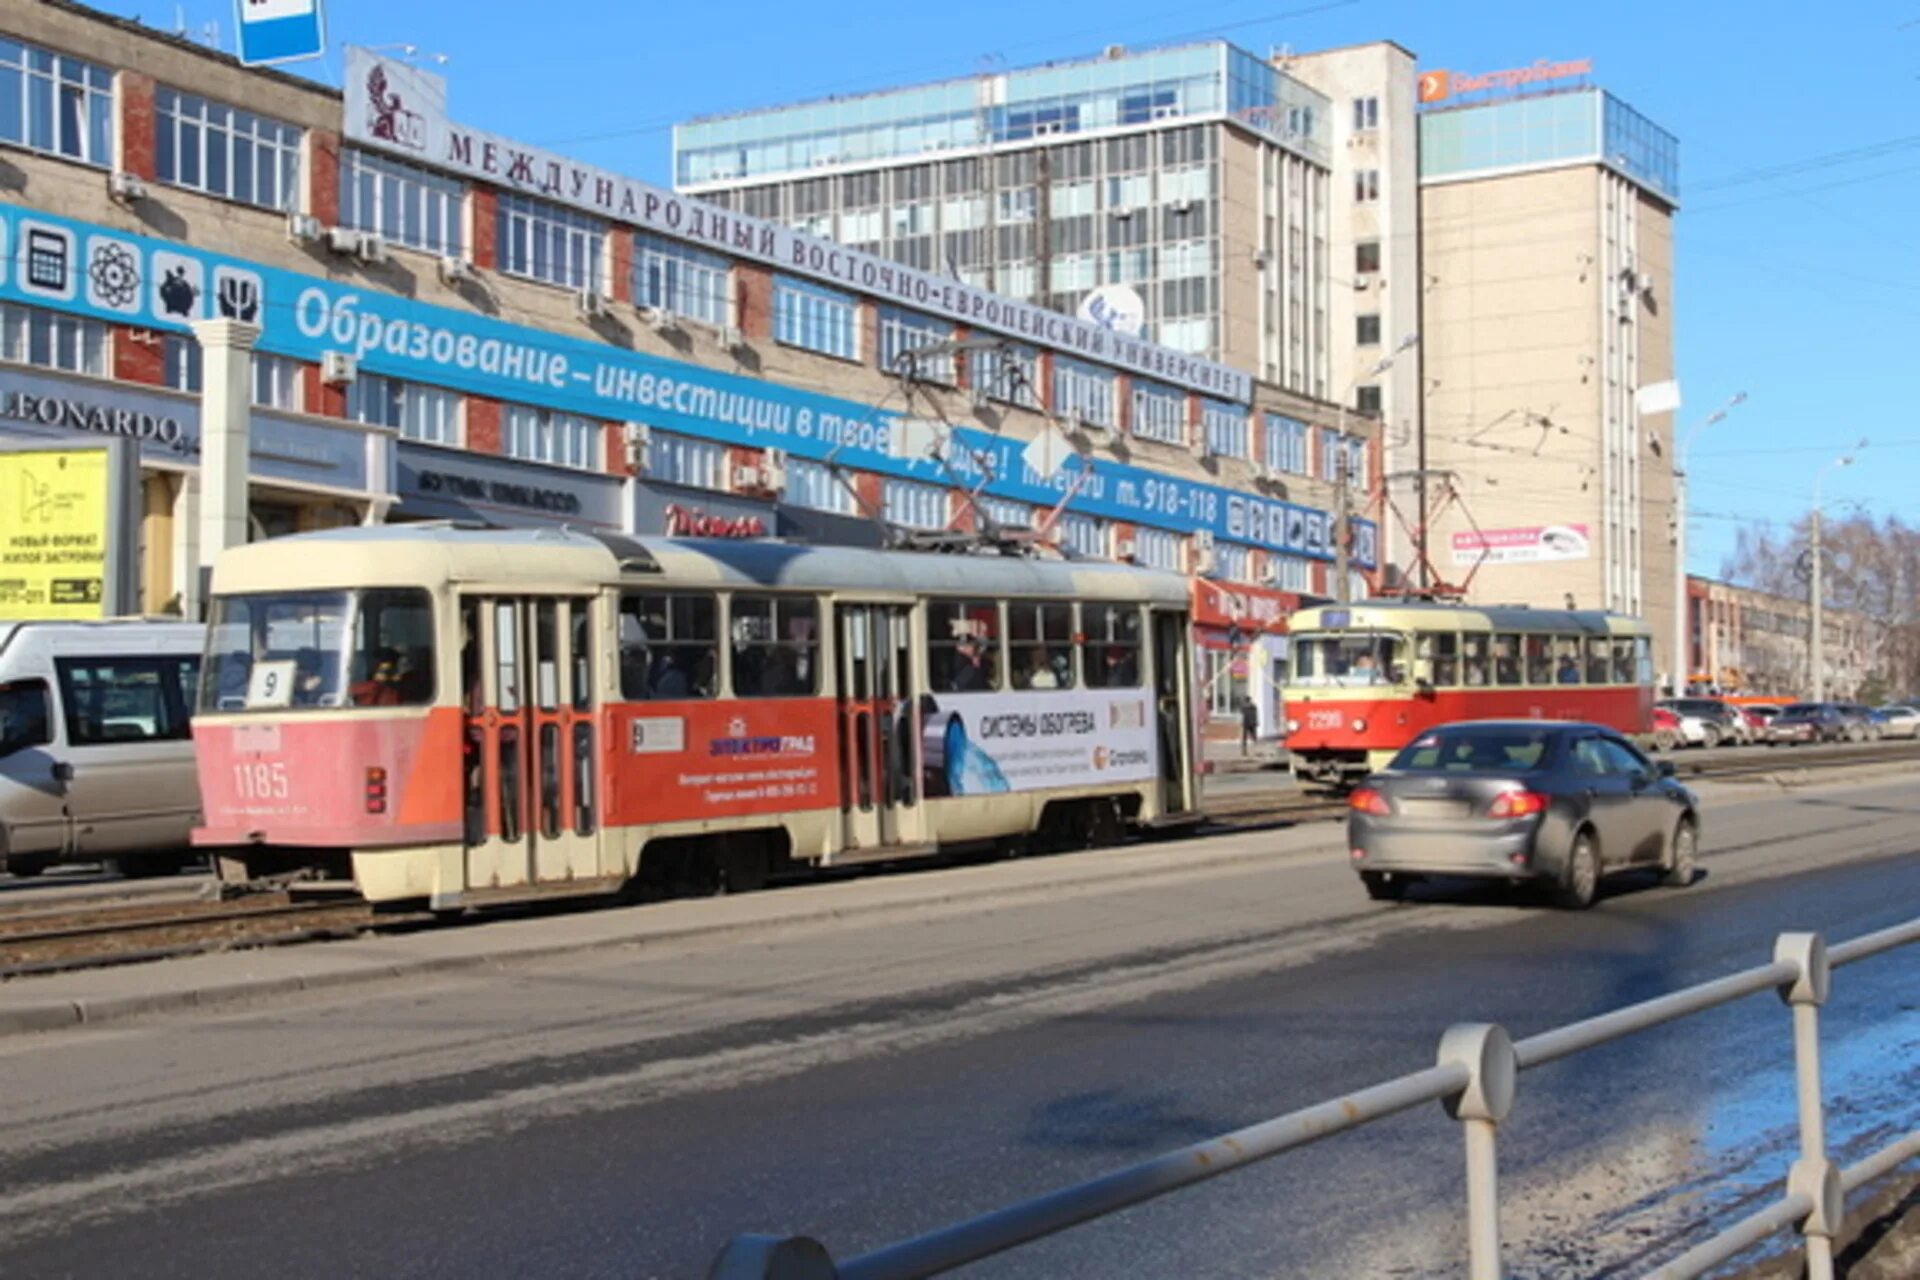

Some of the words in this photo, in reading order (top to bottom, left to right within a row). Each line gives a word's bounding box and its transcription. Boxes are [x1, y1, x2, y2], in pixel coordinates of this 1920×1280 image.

[447, 130, 777, 257] МЕЖДУНАРОДНЫЙ
[791, 238, 1101, 352] ВОСТОЧНО-ЕВРОПЕЙСКИЙ
[1110, 337, 1244, 397] УНИВЕРСИТЕТ
[295, 286, 566, 388] Образование
[597, 360, 791, 438] инвестиции
[796, 406, 812, 438] в
[0, 390, 181, 446] LEONARDO
[264, 671, 278, 697] 9
[980, 714, 1037, 739] СИСТЕМЫ
[234, 762, 288, 799] 1185
